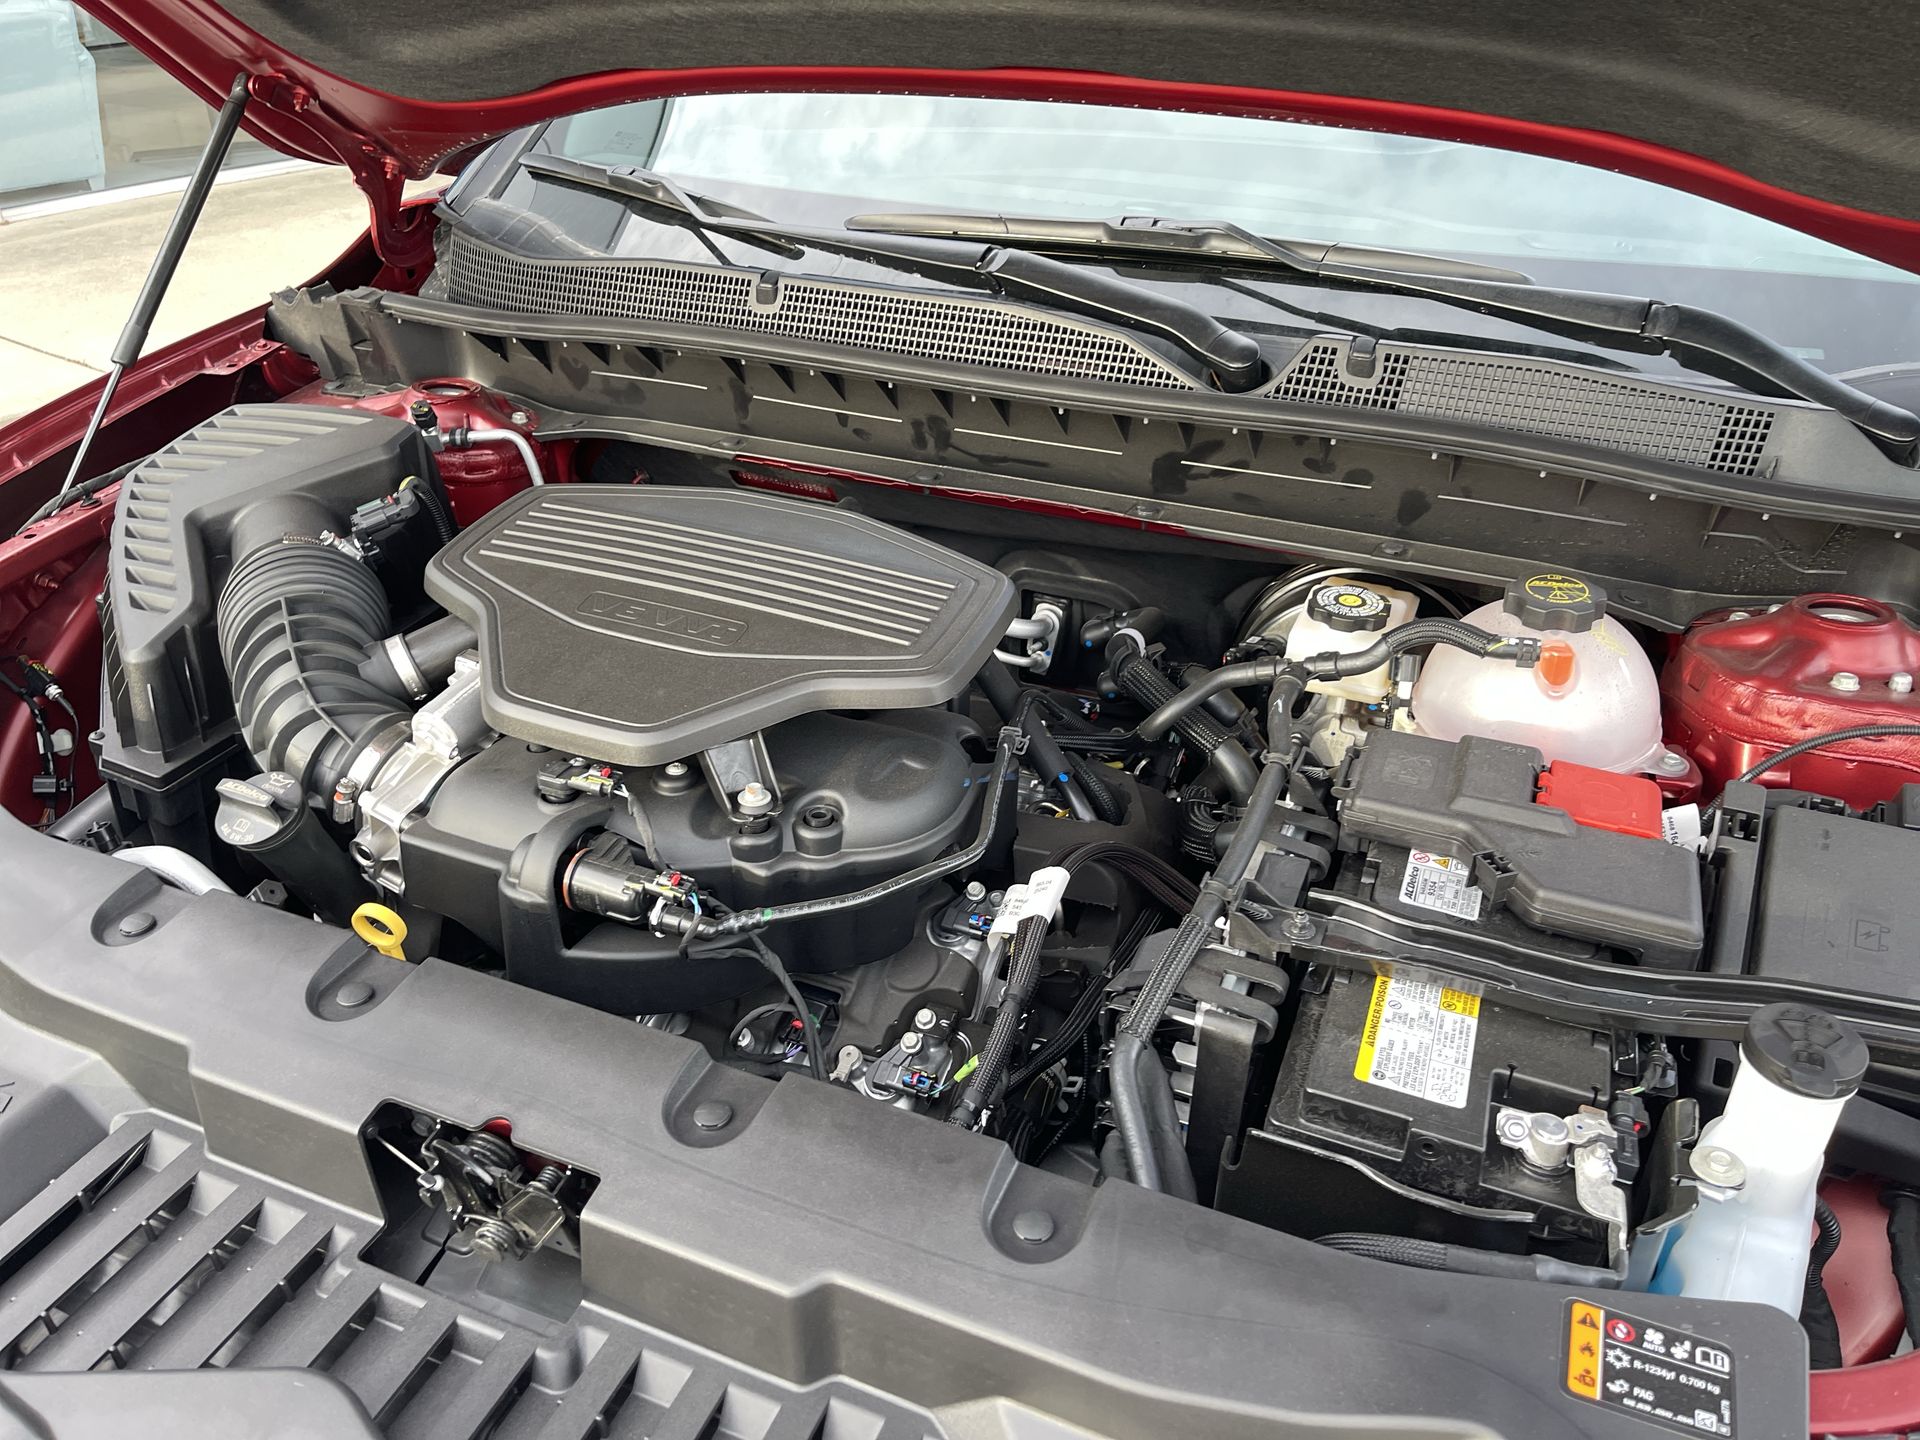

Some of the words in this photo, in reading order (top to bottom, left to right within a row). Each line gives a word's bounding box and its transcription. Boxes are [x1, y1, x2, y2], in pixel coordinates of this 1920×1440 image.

[1404, 866, 1420, 900] ACDelco
[1368, 979, 1389, 1042] DANGER/POISON
[1642, 1341, 1666, 1353] AUTO
[1633, 1387, 1654, 1401] PAG
[1707, 1382, 1721, 1395] kg
